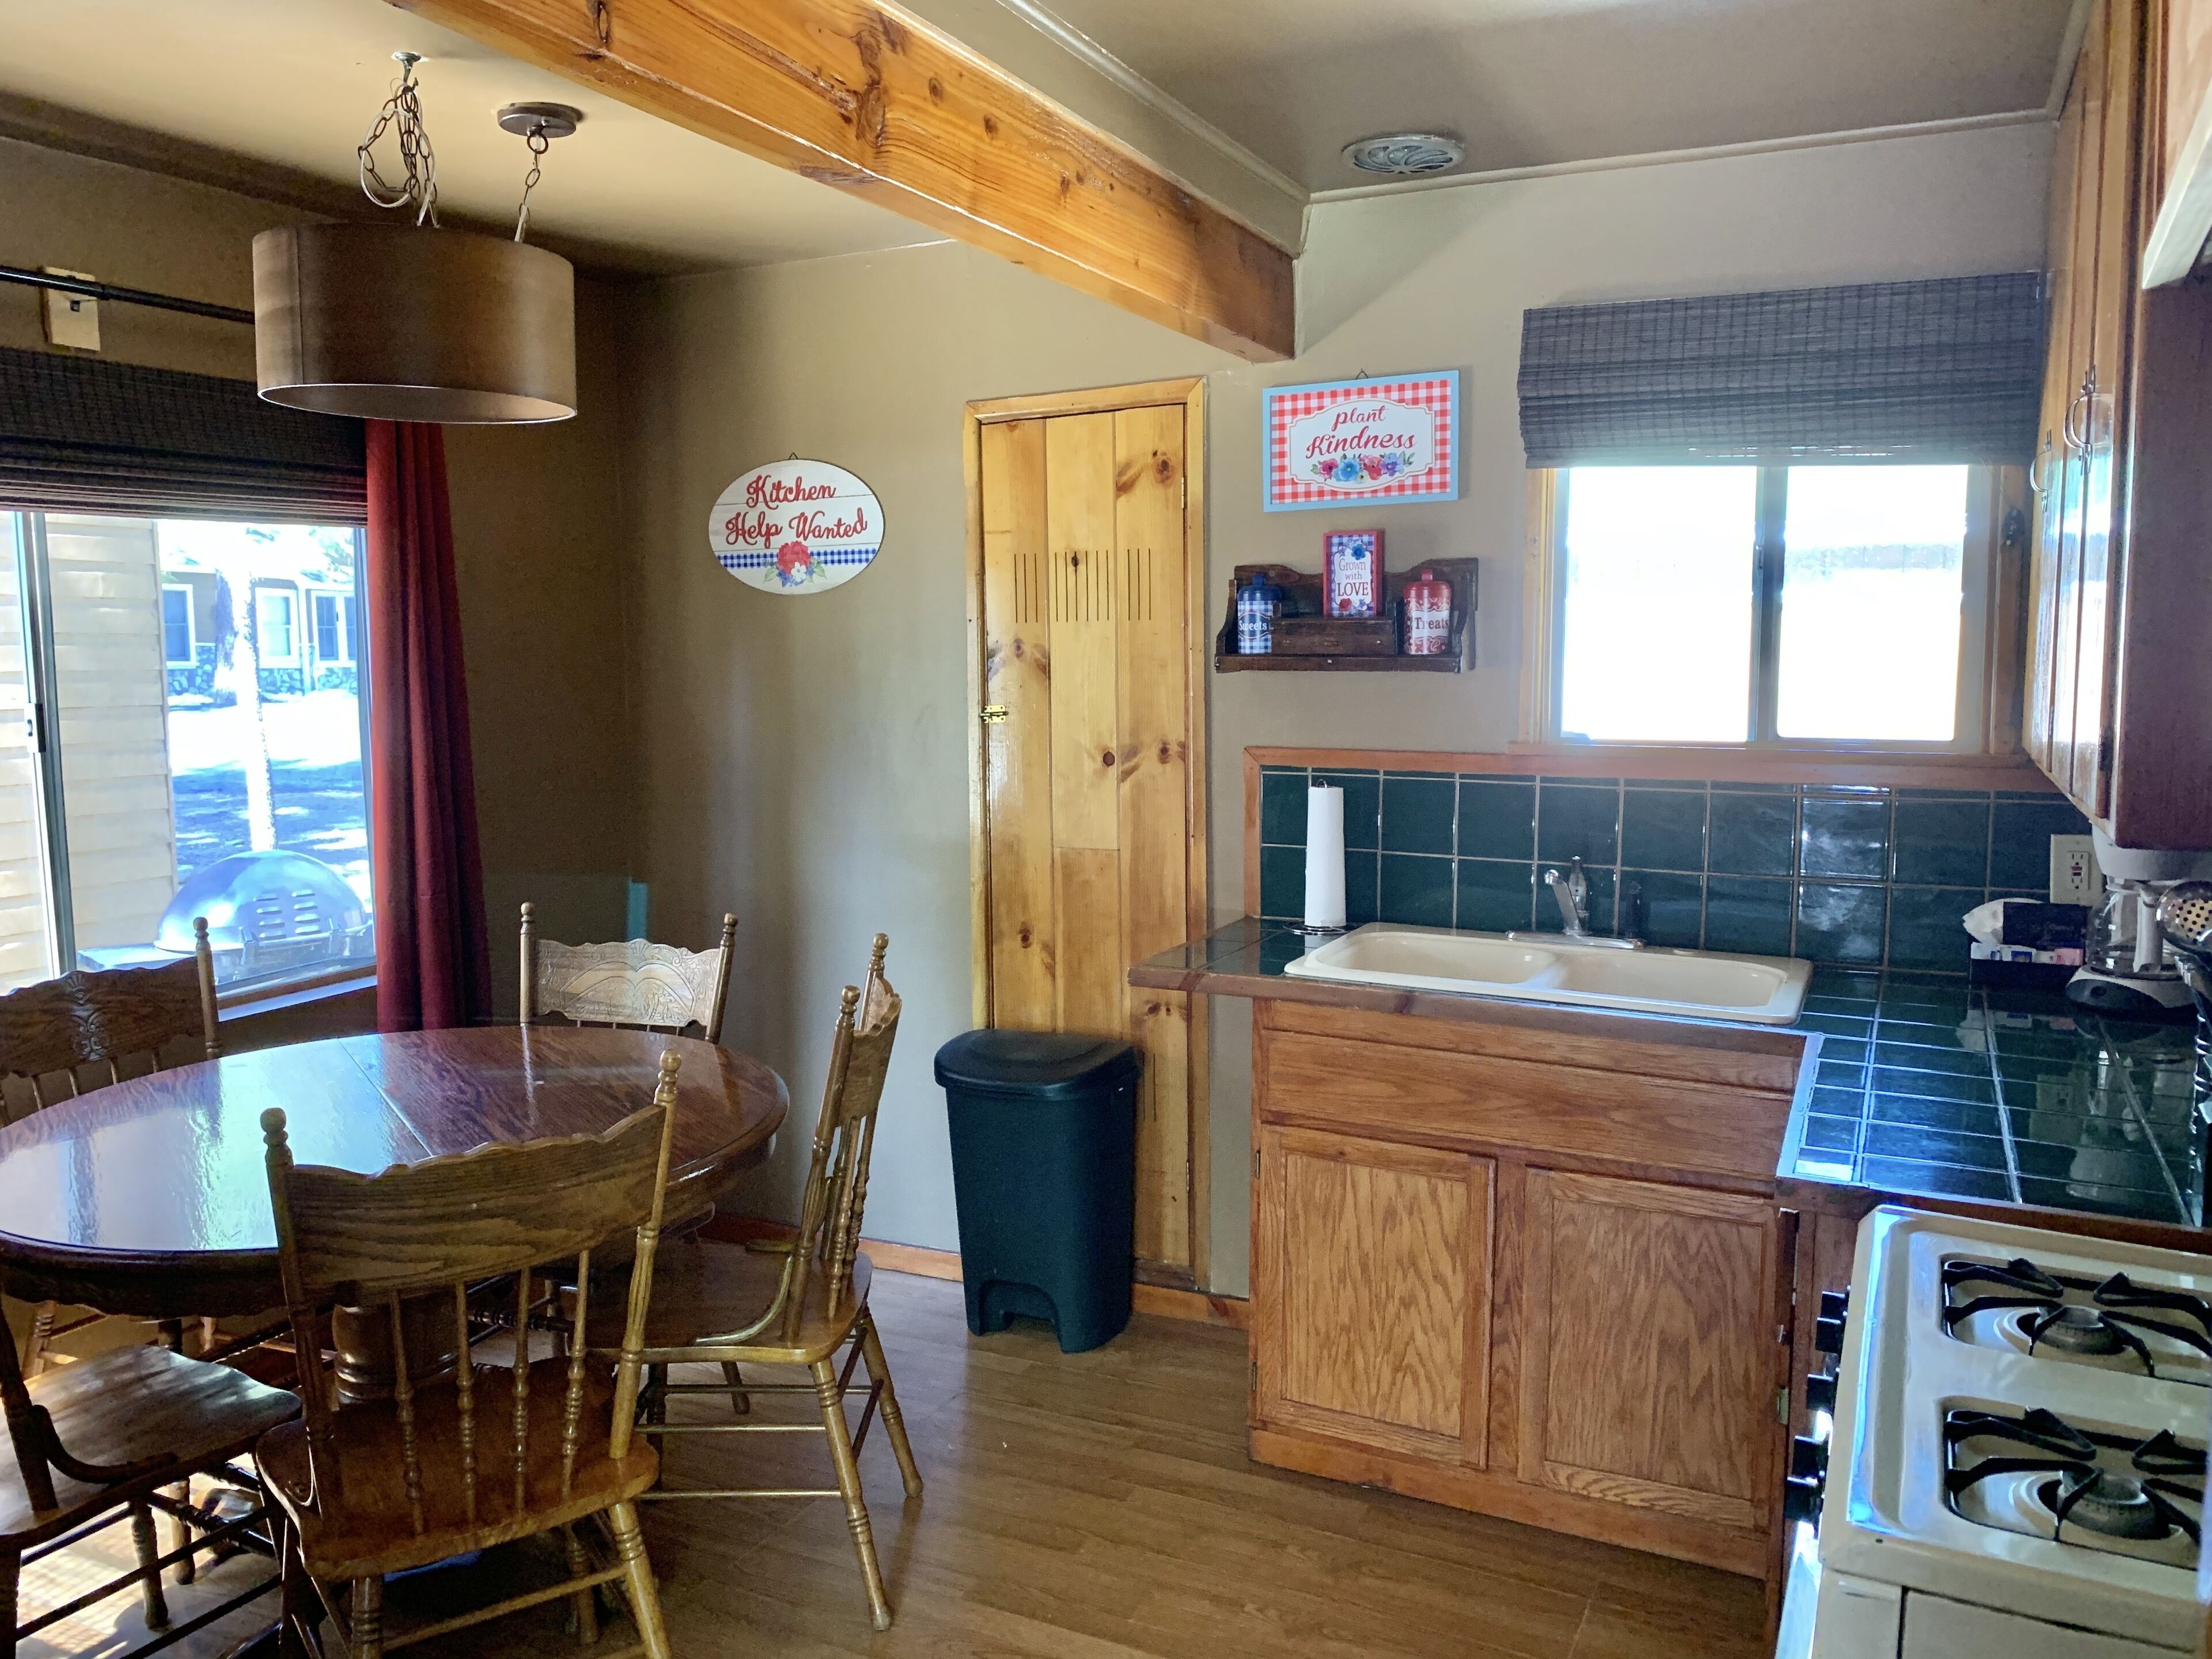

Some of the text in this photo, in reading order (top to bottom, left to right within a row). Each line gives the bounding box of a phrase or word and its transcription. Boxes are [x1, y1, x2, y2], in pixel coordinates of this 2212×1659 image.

[1305, 425, 1416, 459] Kindness
[746, 474, 837, 510] Kitchen
[725, 507, 868, 550] Help Wanted
[1339, 558, 1366, 571] Grown
[1345, 571, 1362, 580] with
[1337, 582, 1369, 597] LOVE
[1239, 620, 1267, 631] Sweets
[1415, 617, 1449, 630] Treats
